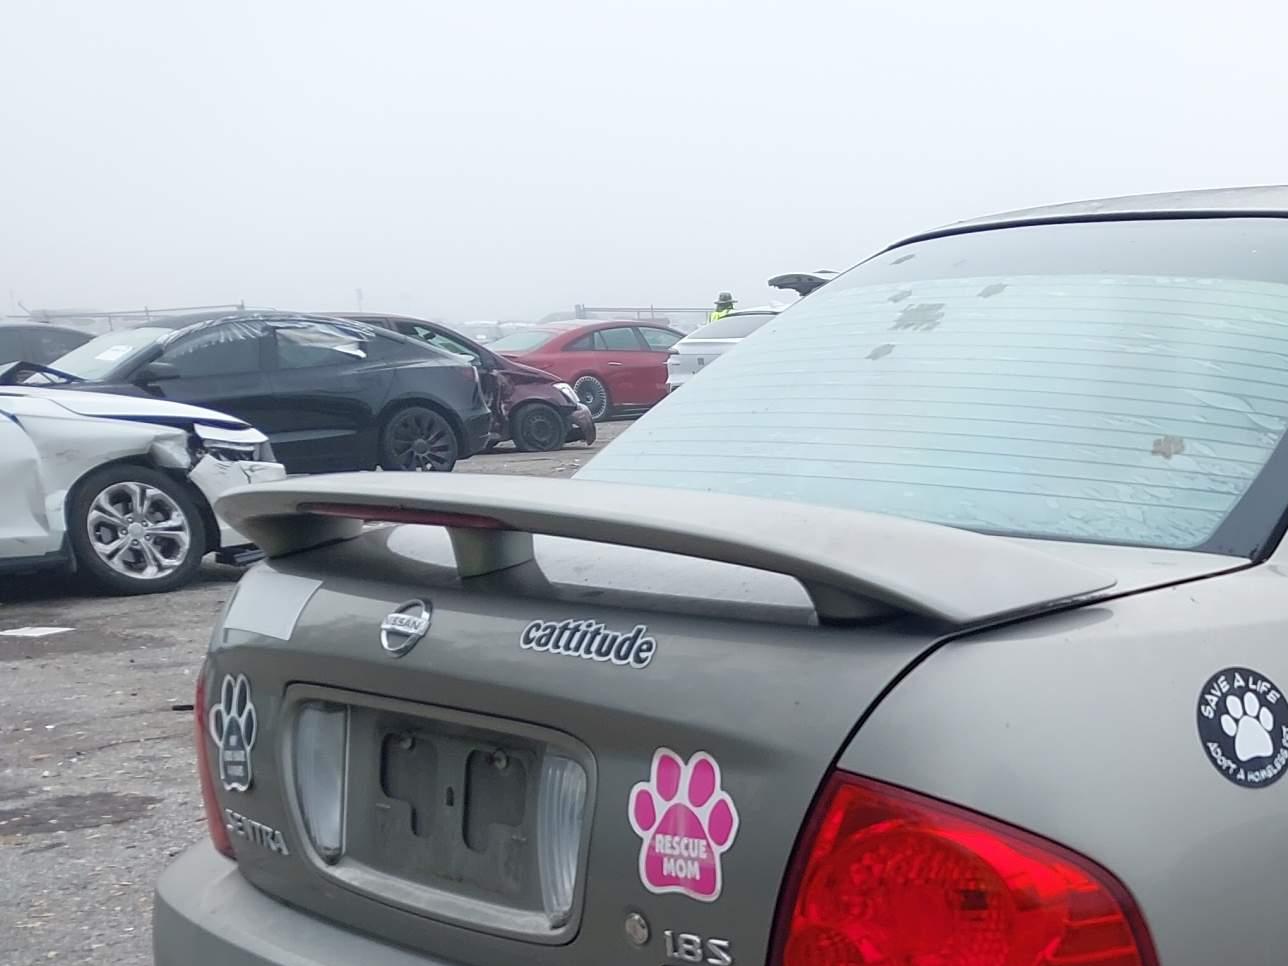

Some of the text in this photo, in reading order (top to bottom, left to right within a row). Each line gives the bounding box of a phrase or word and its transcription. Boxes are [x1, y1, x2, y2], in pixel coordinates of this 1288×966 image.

[521, 620, 655, 666] cattitude
[1200, 672, 1281, 719] SAVE A LIFE
[1207, 742, 1237, 774] ADOPT
[1236, 769, 1246, 781] A
[225, 808, 289, 855] SENTRA
[655, 834, 708, 859] RESCUE
[662, 857, 701, 880] MOM
